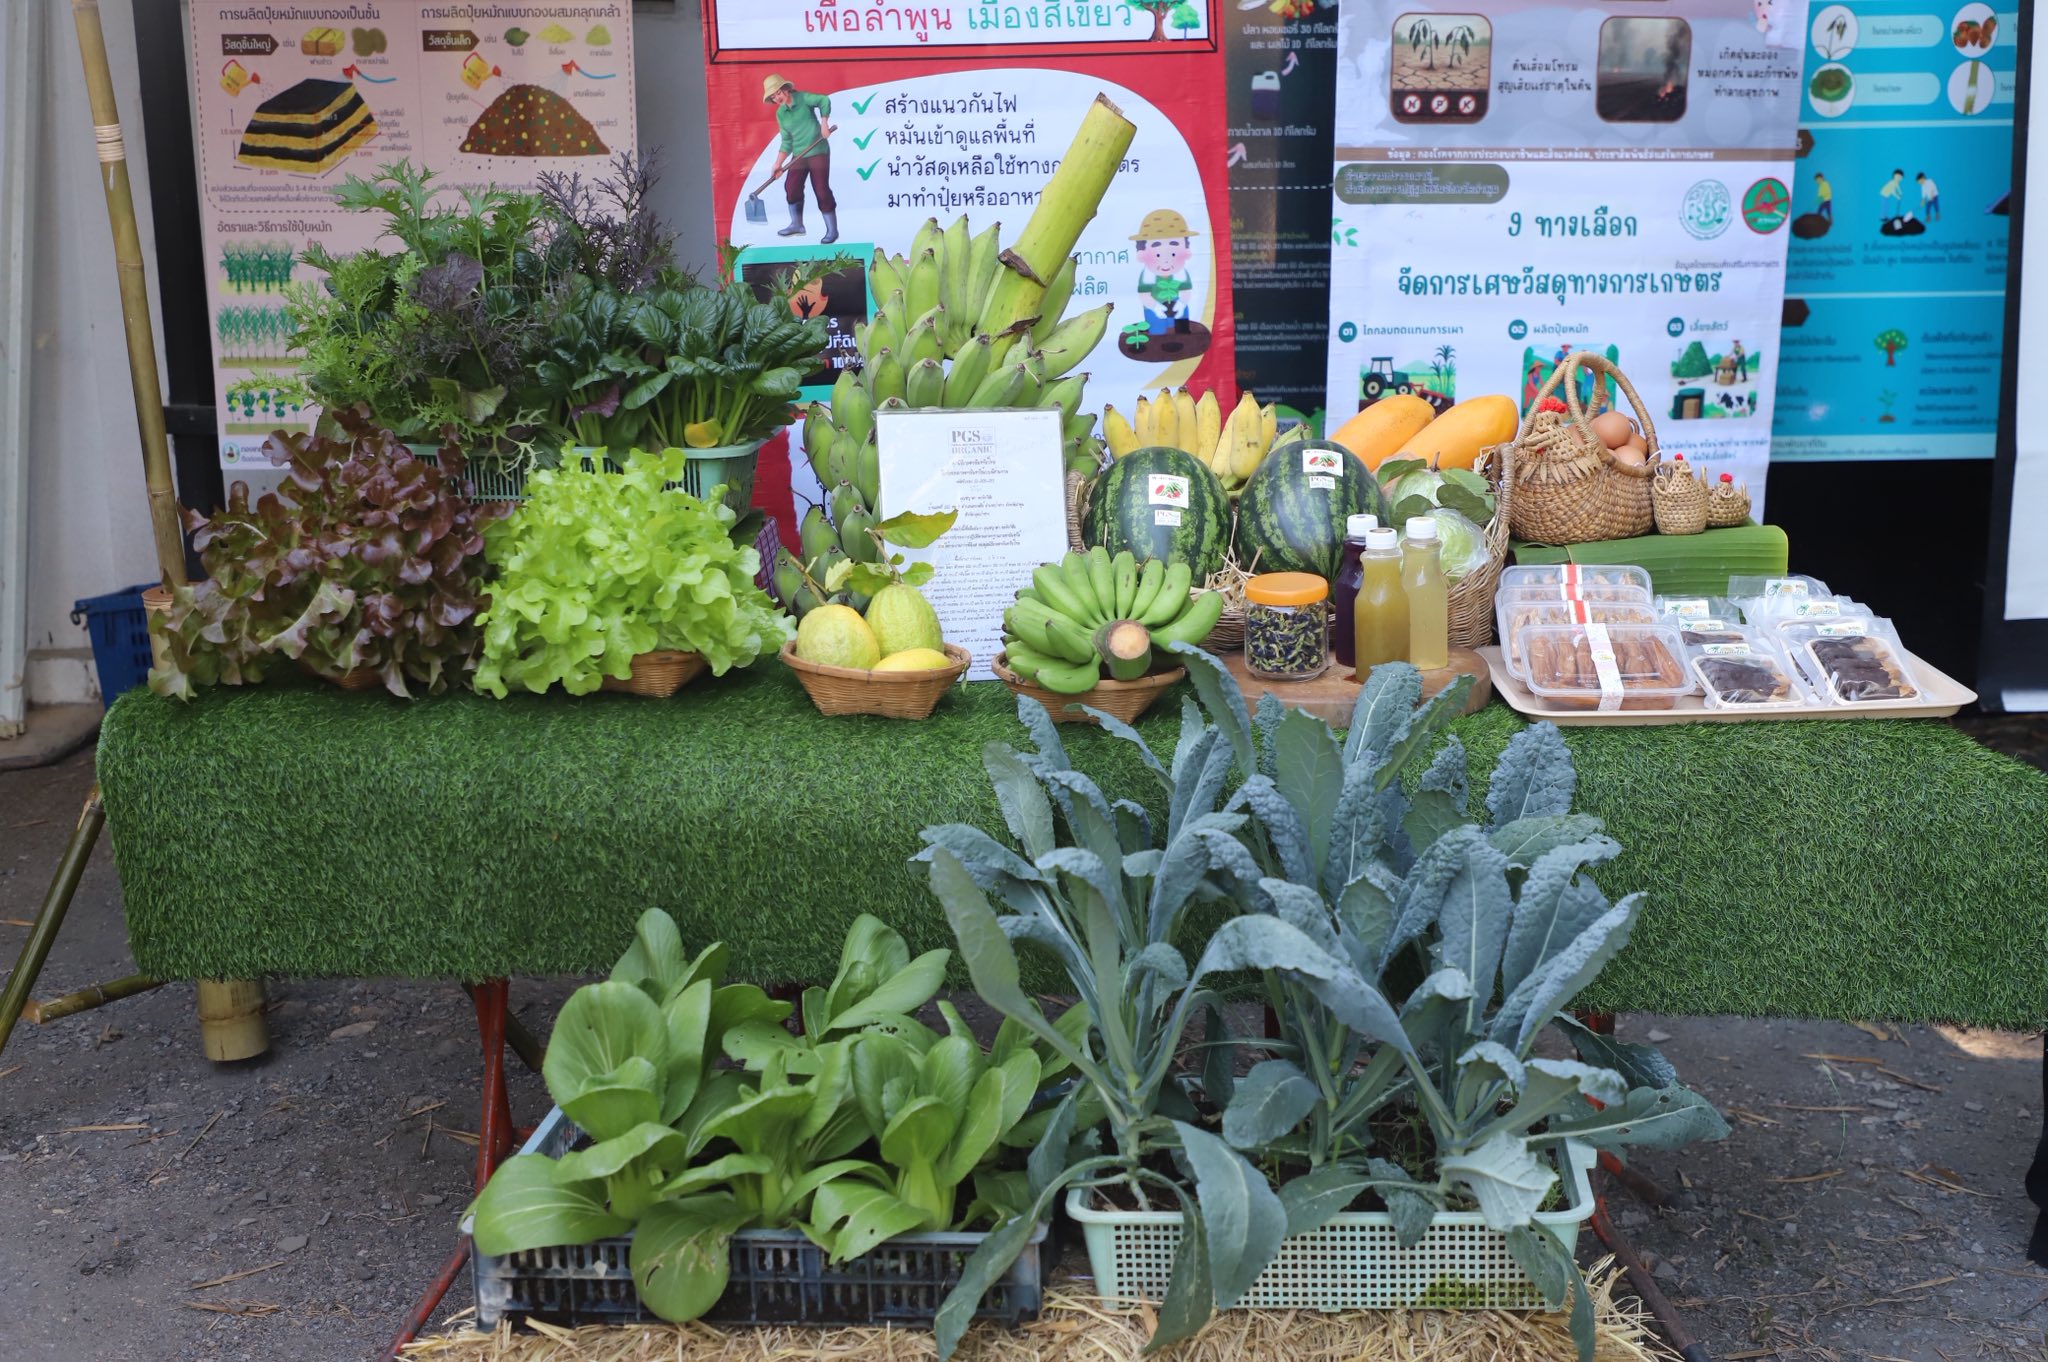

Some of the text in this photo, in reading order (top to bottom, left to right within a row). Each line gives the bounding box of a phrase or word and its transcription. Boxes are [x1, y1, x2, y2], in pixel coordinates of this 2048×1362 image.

[804, 0, 953, 42] เพือลำพูน
[885, 91, 1017, 114] สร้างแนวกันไฟ
[885, 118, 1036, 151] หมั่นเข้าดูแลพื้นที่
[887, 153, 1140, 182] นำวัสดุเหลือใช้ทางกตร
[888, 185, 1043, 212] มาทำปุ๋ยหรืออาหา
[1535, 205, 1637, 238] ทางเลือก
[1398, 264, 1722, 306] จัดการเศษวัสดุทางการเกษตร
[951, 429, 981, 443] PGS
